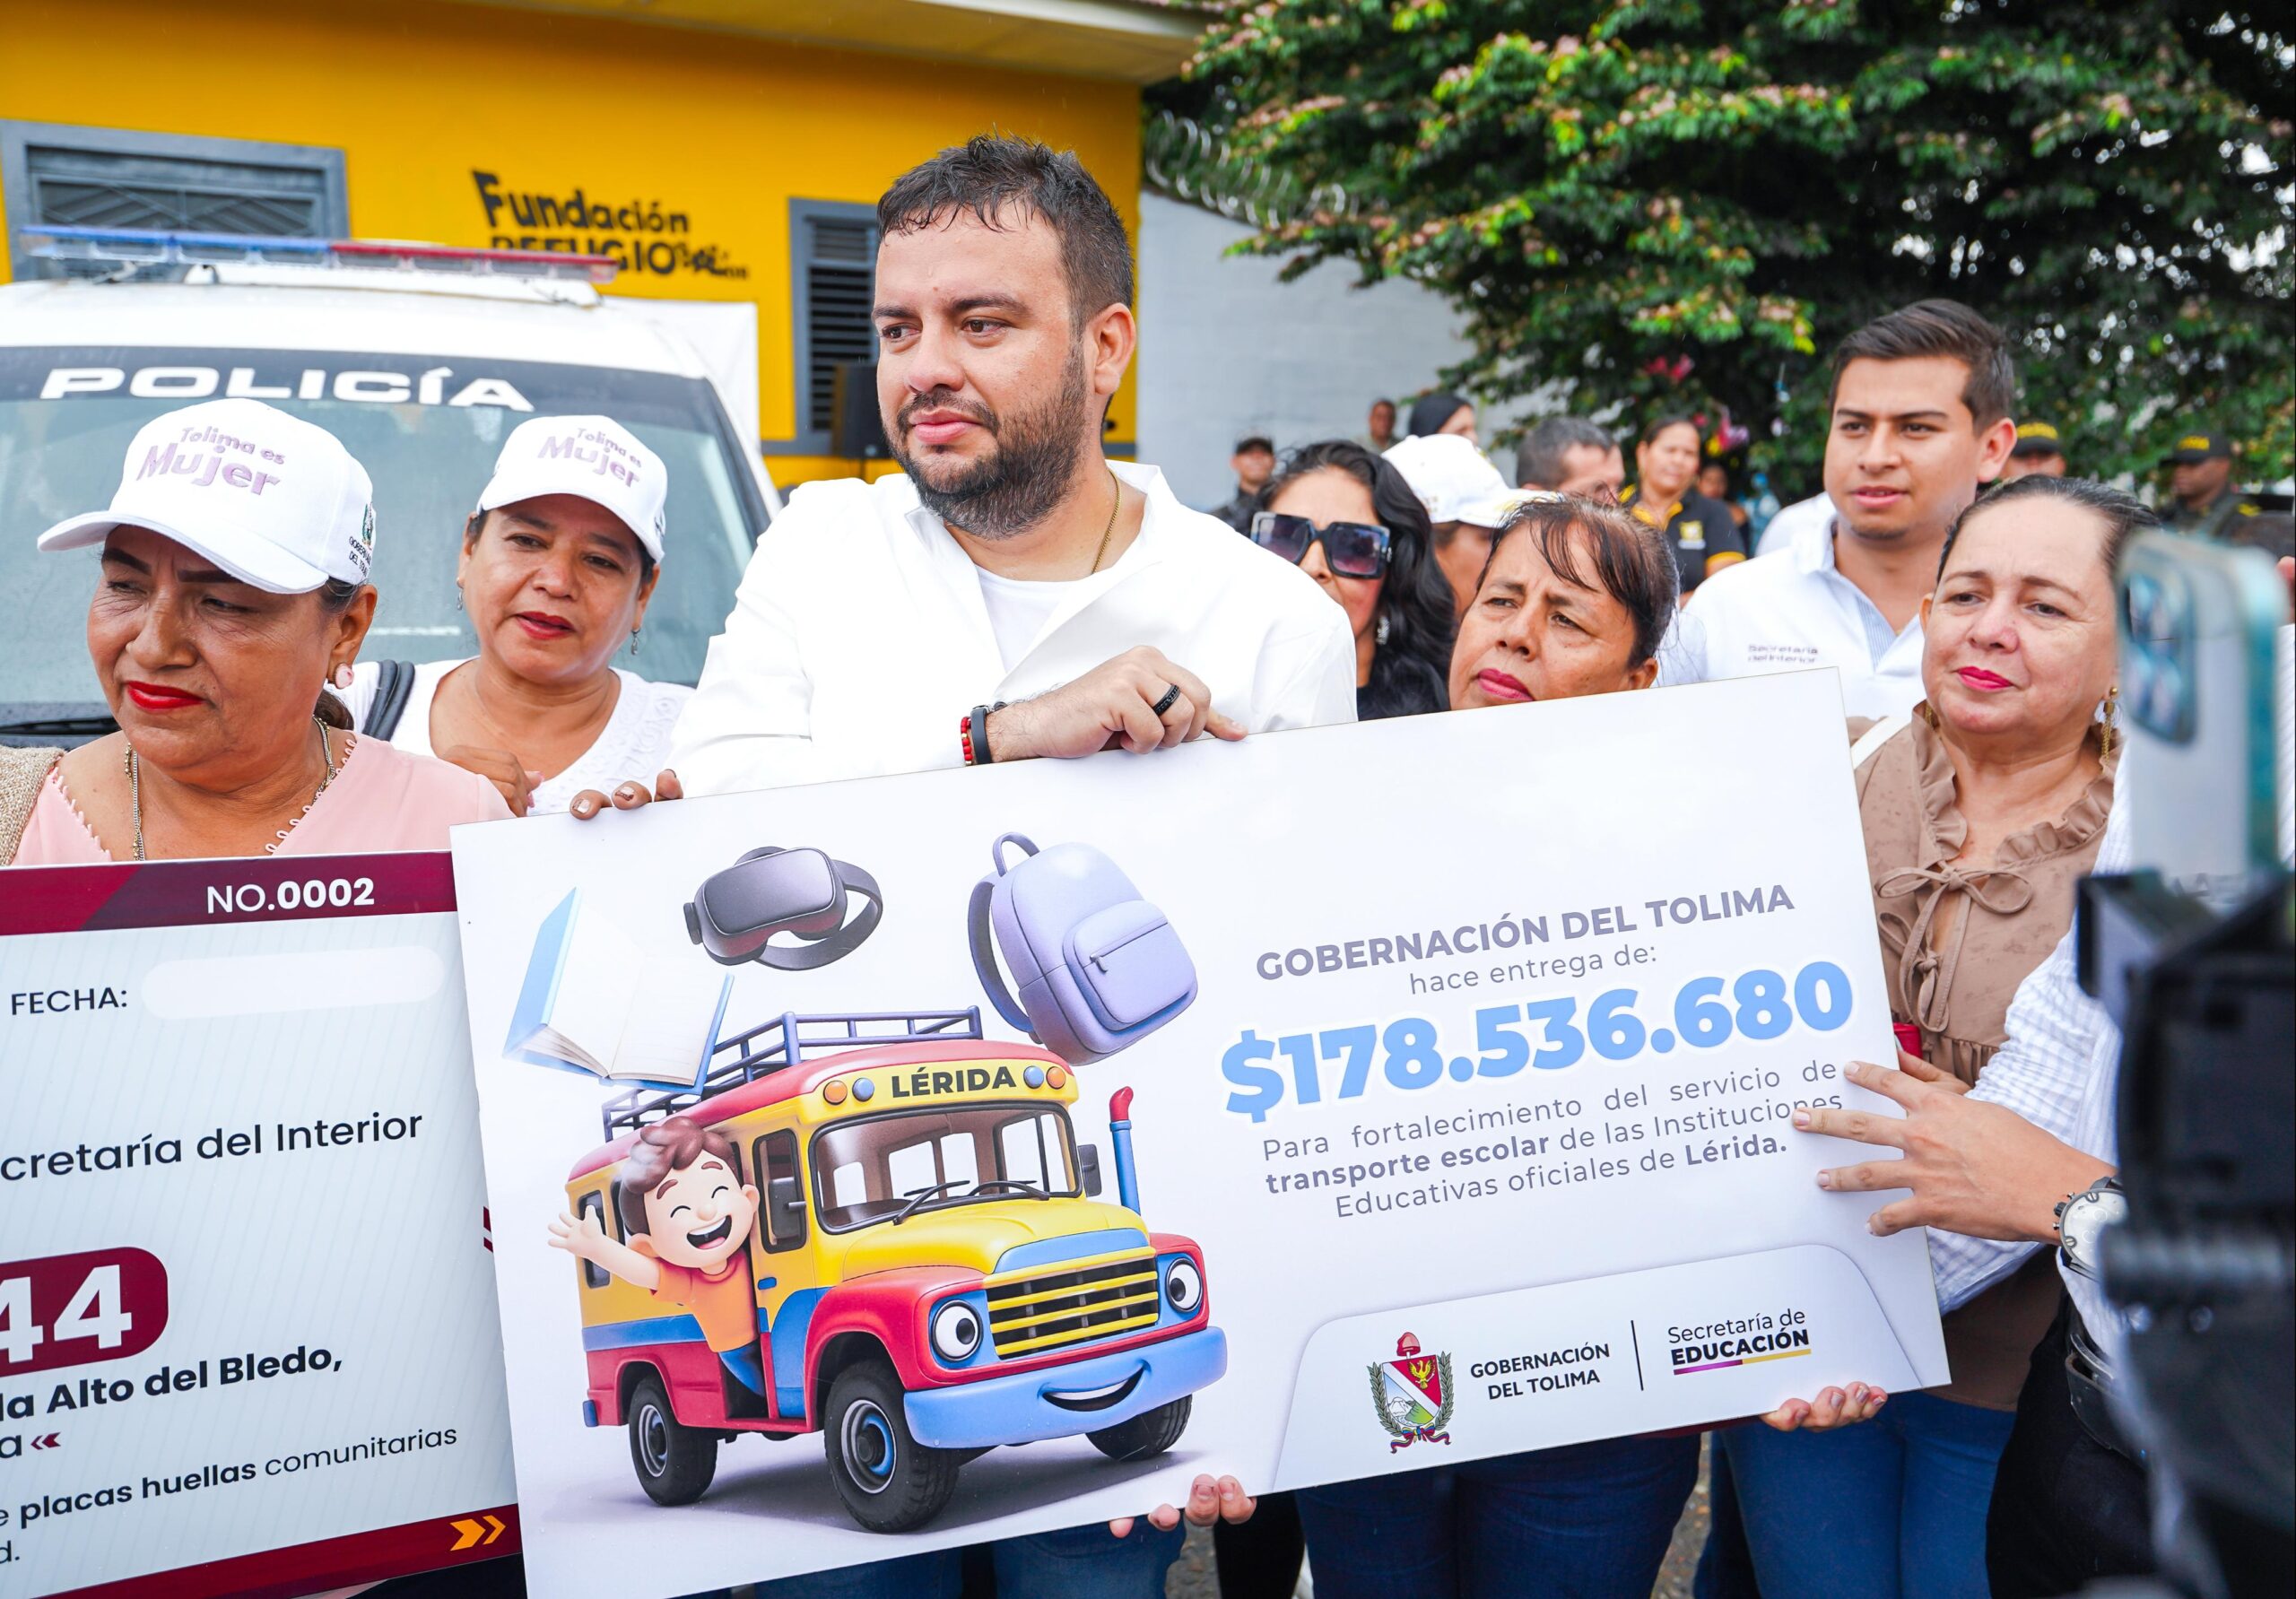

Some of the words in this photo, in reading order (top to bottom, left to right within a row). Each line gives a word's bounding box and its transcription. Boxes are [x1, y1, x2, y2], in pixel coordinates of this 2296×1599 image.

[471, 169, 689, 233] Fundación
[39, 366, 535, 413] POLICÍA
[179, 425, 257, 455] Tolima
[260, 448, 285, 465] es
[537, 435, 640, 488] Mujer
[577, 428, 627, 456] Tolima
[135, 442, 281, 496] Mujer
[206, 876, 375, 915] NO.0002
[1256, 912, 1550, 981] GOBERNACIÓN
[1561, 906, 1638, 941] DEL
[1644, 884, 1796, 928] TOLIMA
[1409, 970, 1479, 995] hace
[1489, 953, 1604, 984] entrega
[1613, 943, 1657, 967] de:
[10, 986, 128, 1016] FECHA:
[1221, 960, 1854, 1124] $178.536.680
[891, 1065, 1017, 1099] LÉRIDA
[1263, 1136, 1329, 1161] Para
[1351, 1099, 1582, 1149] fortalecimiento
[1604, 1083, 1648, 1111] del
[1669, 1066, 1780, 1102] servicio
[1802, 1059, 1837, 1082] de
[0, 1132, 182, 1182] cretaría
[196, 1123, 262, 1160] del
[276, 1111, 423, 1152] Interior
[1265, 1153, 1431, 1195] transporte
[1440, 1135, 1550, 1169] escolar
[1560, 1126, 1596, 1151] de
[1605, 1121, 1645, 1144] las
[1335, 1178, 1499, 1219] Educativas
[1508, 1157, 1631, 1192] oficiales
[1639, 1148, 1675, 1172] de
[1684, 1132, 1787, 1166] Lérida.
[1667, 1312, 1774, 1344] Secretaría
[1779, 1308, 1806, 1327] de
[1670, 1326, 1810, 1367] EDUCACIÓN
[47, 1377, 135, 1414] Alto
[144, 1359, 208, 1397] del
[219, 1344, 343, 1386] Bledo,
[1470, 1341, 1611, 1379] GOBERNACIÓN
[1487, 1380, 1525, 1401] DEL
[1526, 1369, 1601, 1394] TOLIMA
[20, 1484, 133, 1530] placas
[141, 1464, 257, 1499] huellas
[265, 1428, 457, 1476] comunitarias
